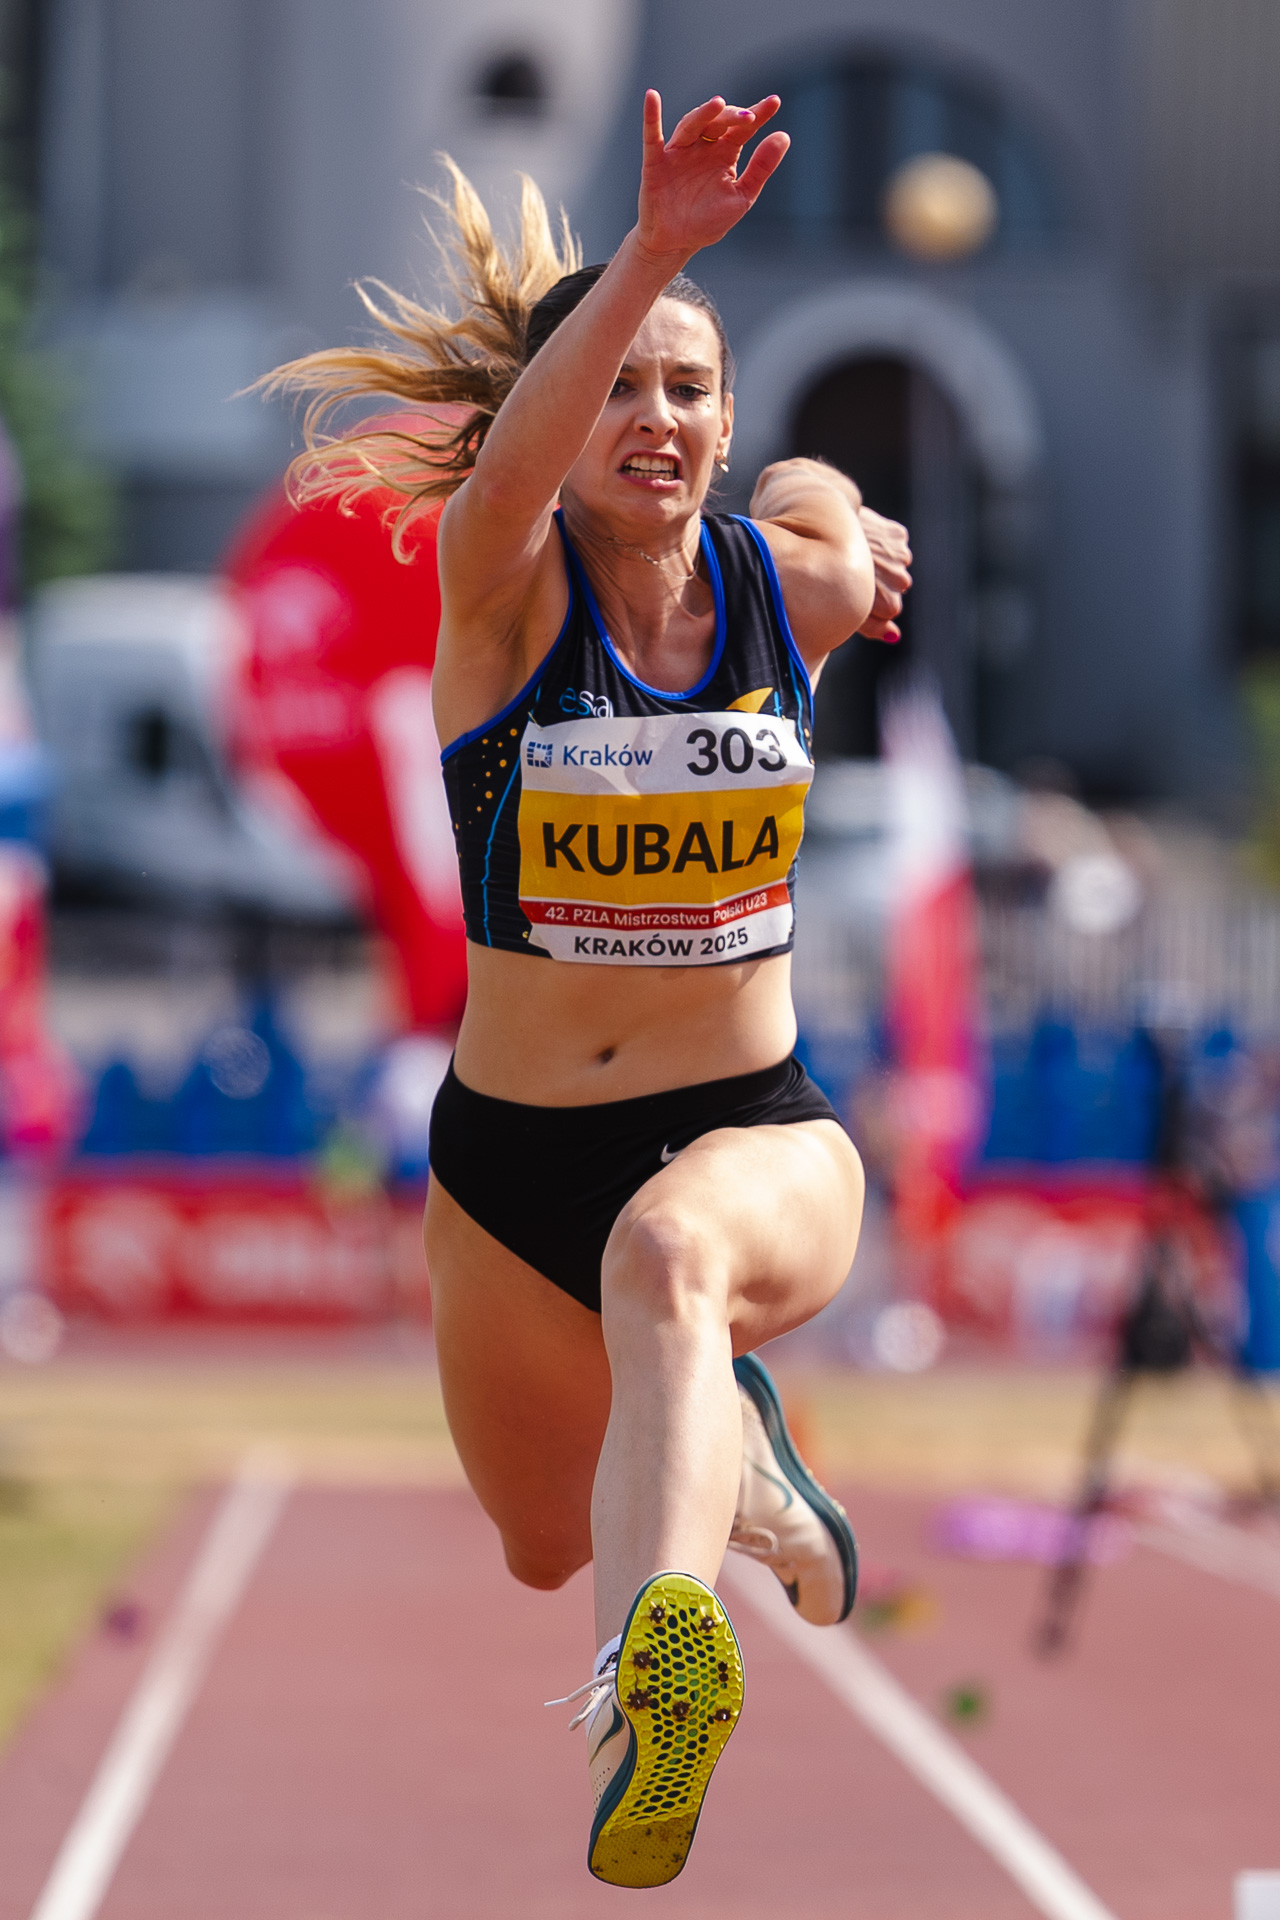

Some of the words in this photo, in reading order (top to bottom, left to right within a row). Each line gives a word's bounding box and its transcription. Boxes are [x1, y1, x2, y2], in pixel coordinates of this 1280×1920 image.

[562, 743, 653, 767] Kraków
[686, 726, 788, 776] 303
[542, 815, 780, 876] KUBALA
[545, 906, 569, 921] 42.
[573, 908, 610, 924] PZLA
[614, 911, 710, 926] Mistrzostwa
[713, 899, 744, 923] Polski
[745, 892, 768, 911] U23
[574, 932, 694, 957] KRAKÓW
[700, 926, 749, 956] 2025
